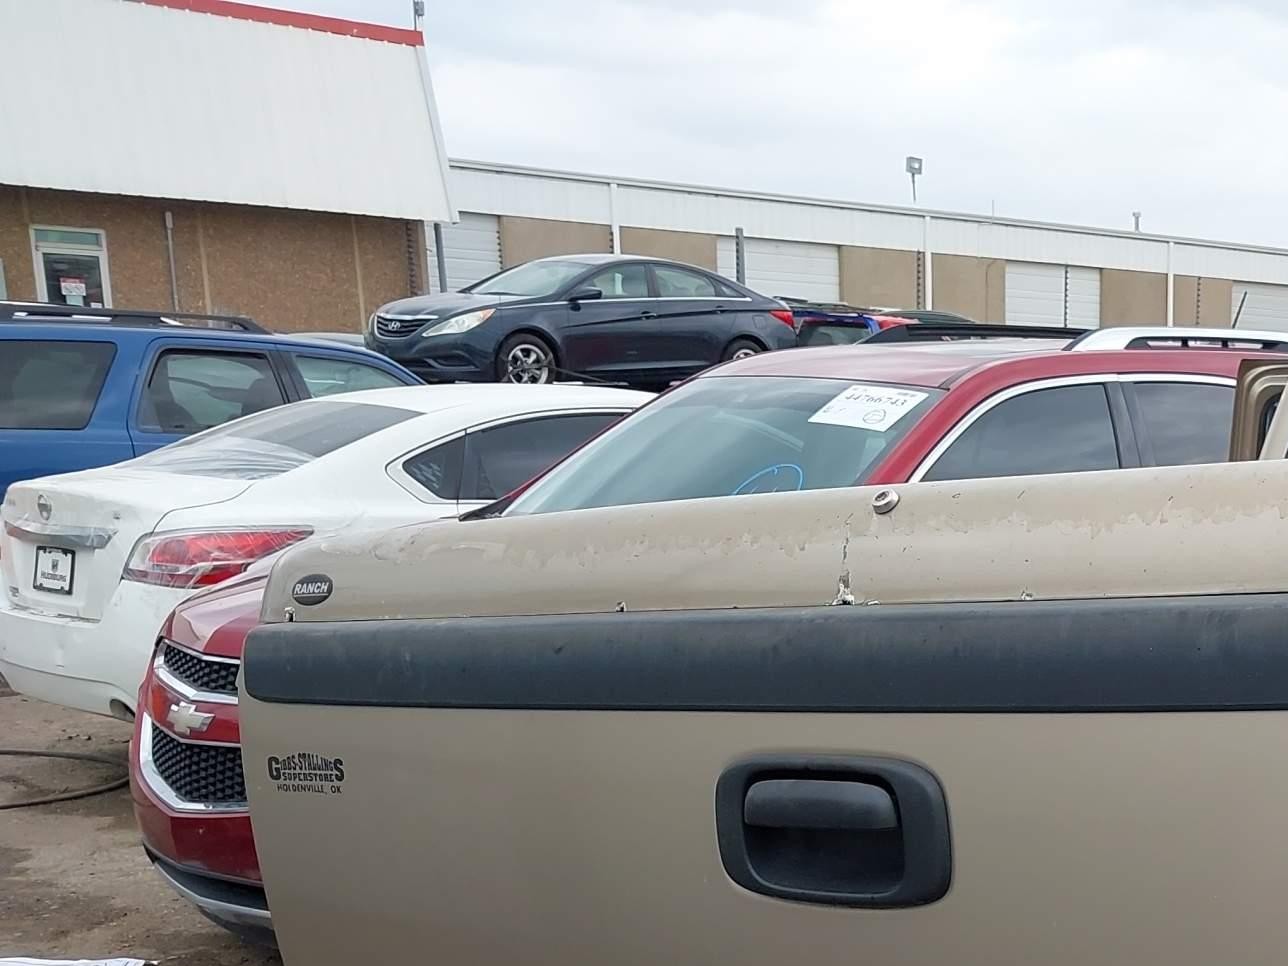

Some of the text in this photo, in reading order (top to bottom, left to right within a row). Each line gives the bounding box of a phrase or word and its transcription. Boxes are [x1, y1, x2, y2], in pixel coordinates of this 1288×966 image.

[293, 582, 330, 595] RANCH
[281, 771, 335, 783] SUPERSTORE
[330, 784, 343, 794] OK
